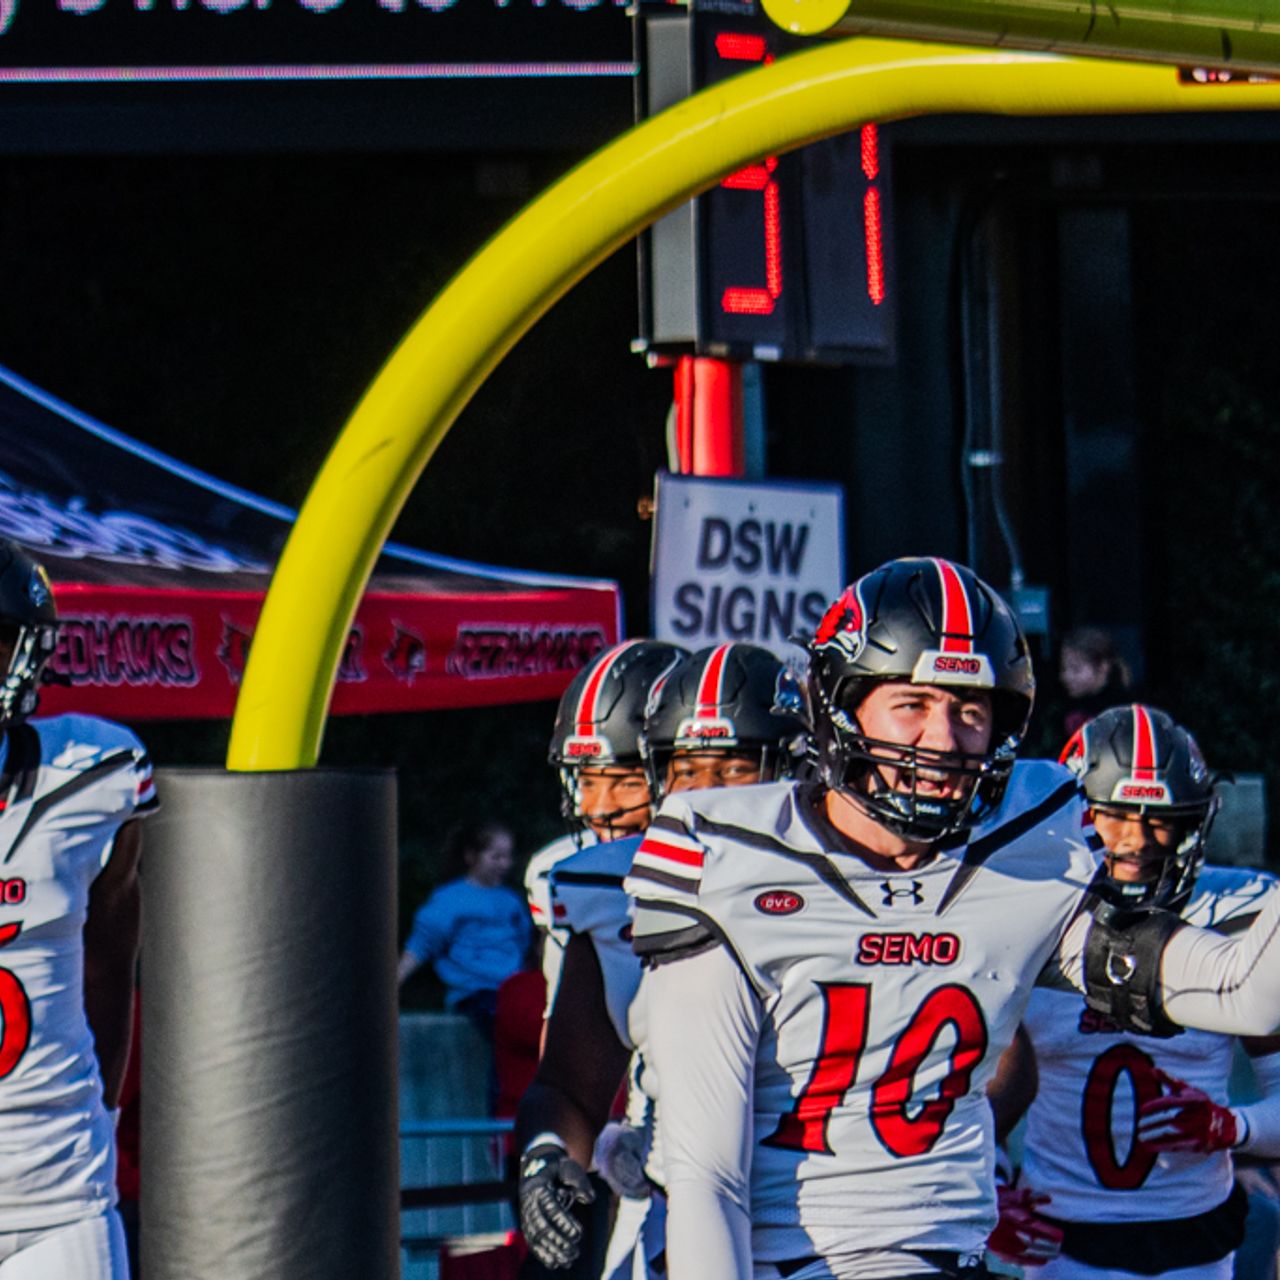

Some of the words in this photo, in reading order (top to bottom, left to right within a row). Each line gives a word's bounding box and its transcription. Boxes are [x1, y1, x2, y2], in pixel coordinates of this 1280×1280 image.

[698, 516, 810, 577] DSW
[672, 582, 827, 641] SIGNS
[48, 615, 200, 687] EDHAWKS
[934, 657, 981, 674] SEMO
[567, 742, 602, 757] SEMO
[1122, 785, 1165, 799] SEMO
[765, 897, 792, 909] OVC
[854, 931, 963, 967] SEMO
[759, 979, 989, 1160] 10
[1081, 1043, 1164, 1192] 0
